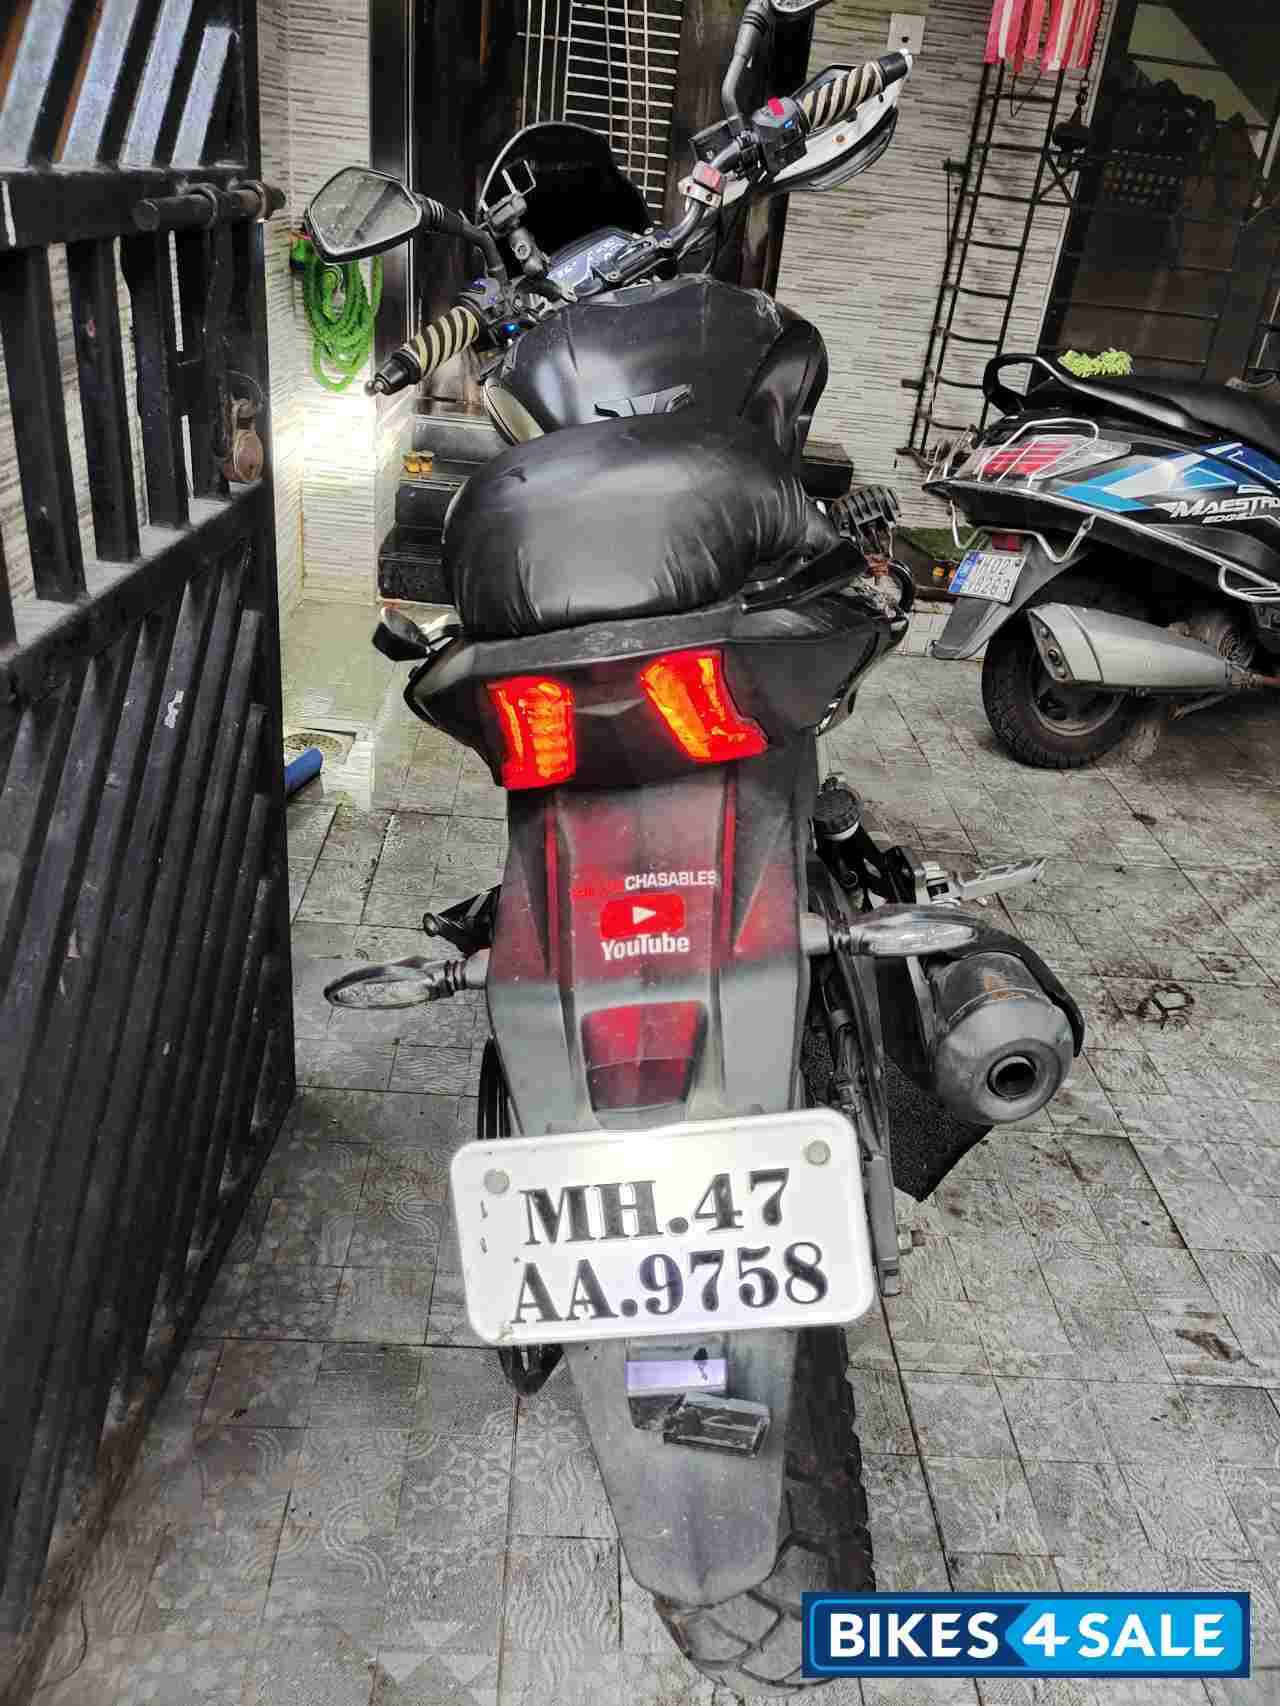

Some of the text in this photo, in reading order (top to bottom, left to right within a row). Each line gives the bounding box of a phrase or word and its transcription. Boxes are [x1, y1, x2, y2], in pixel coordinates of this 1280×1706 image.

[624, 870, 718, 891] CHASABLES
[601, 932, 690, 961] YouTube
[519, 1168, 790, 1245] MH.47
[511, 1241, 829, 1324] AA.9758
